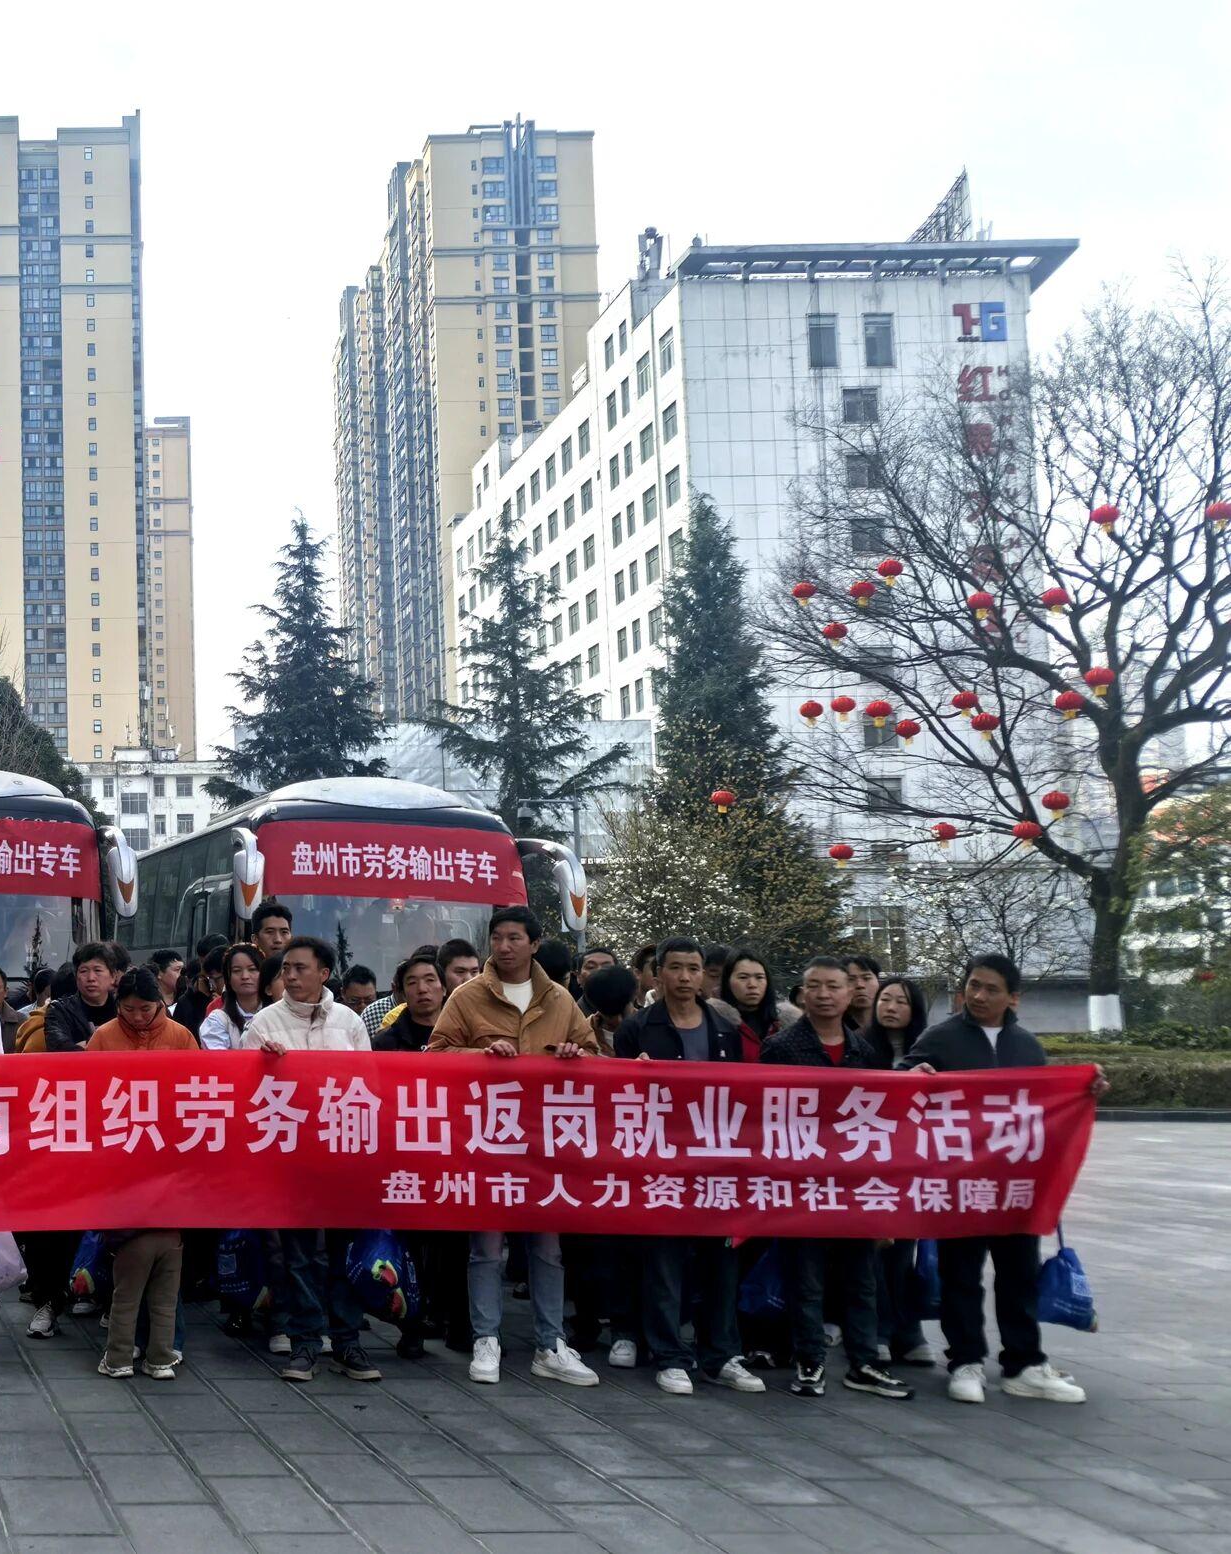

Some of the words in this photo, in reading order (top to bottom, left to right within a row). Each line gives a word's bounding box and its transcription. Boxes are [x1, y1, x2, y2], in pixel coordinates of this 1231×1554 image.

[291, 841, 500, 886] 盘州市劳务输出专车
[381, 1170, 1037, 1214] 盘州市人力资源和社会保障局
